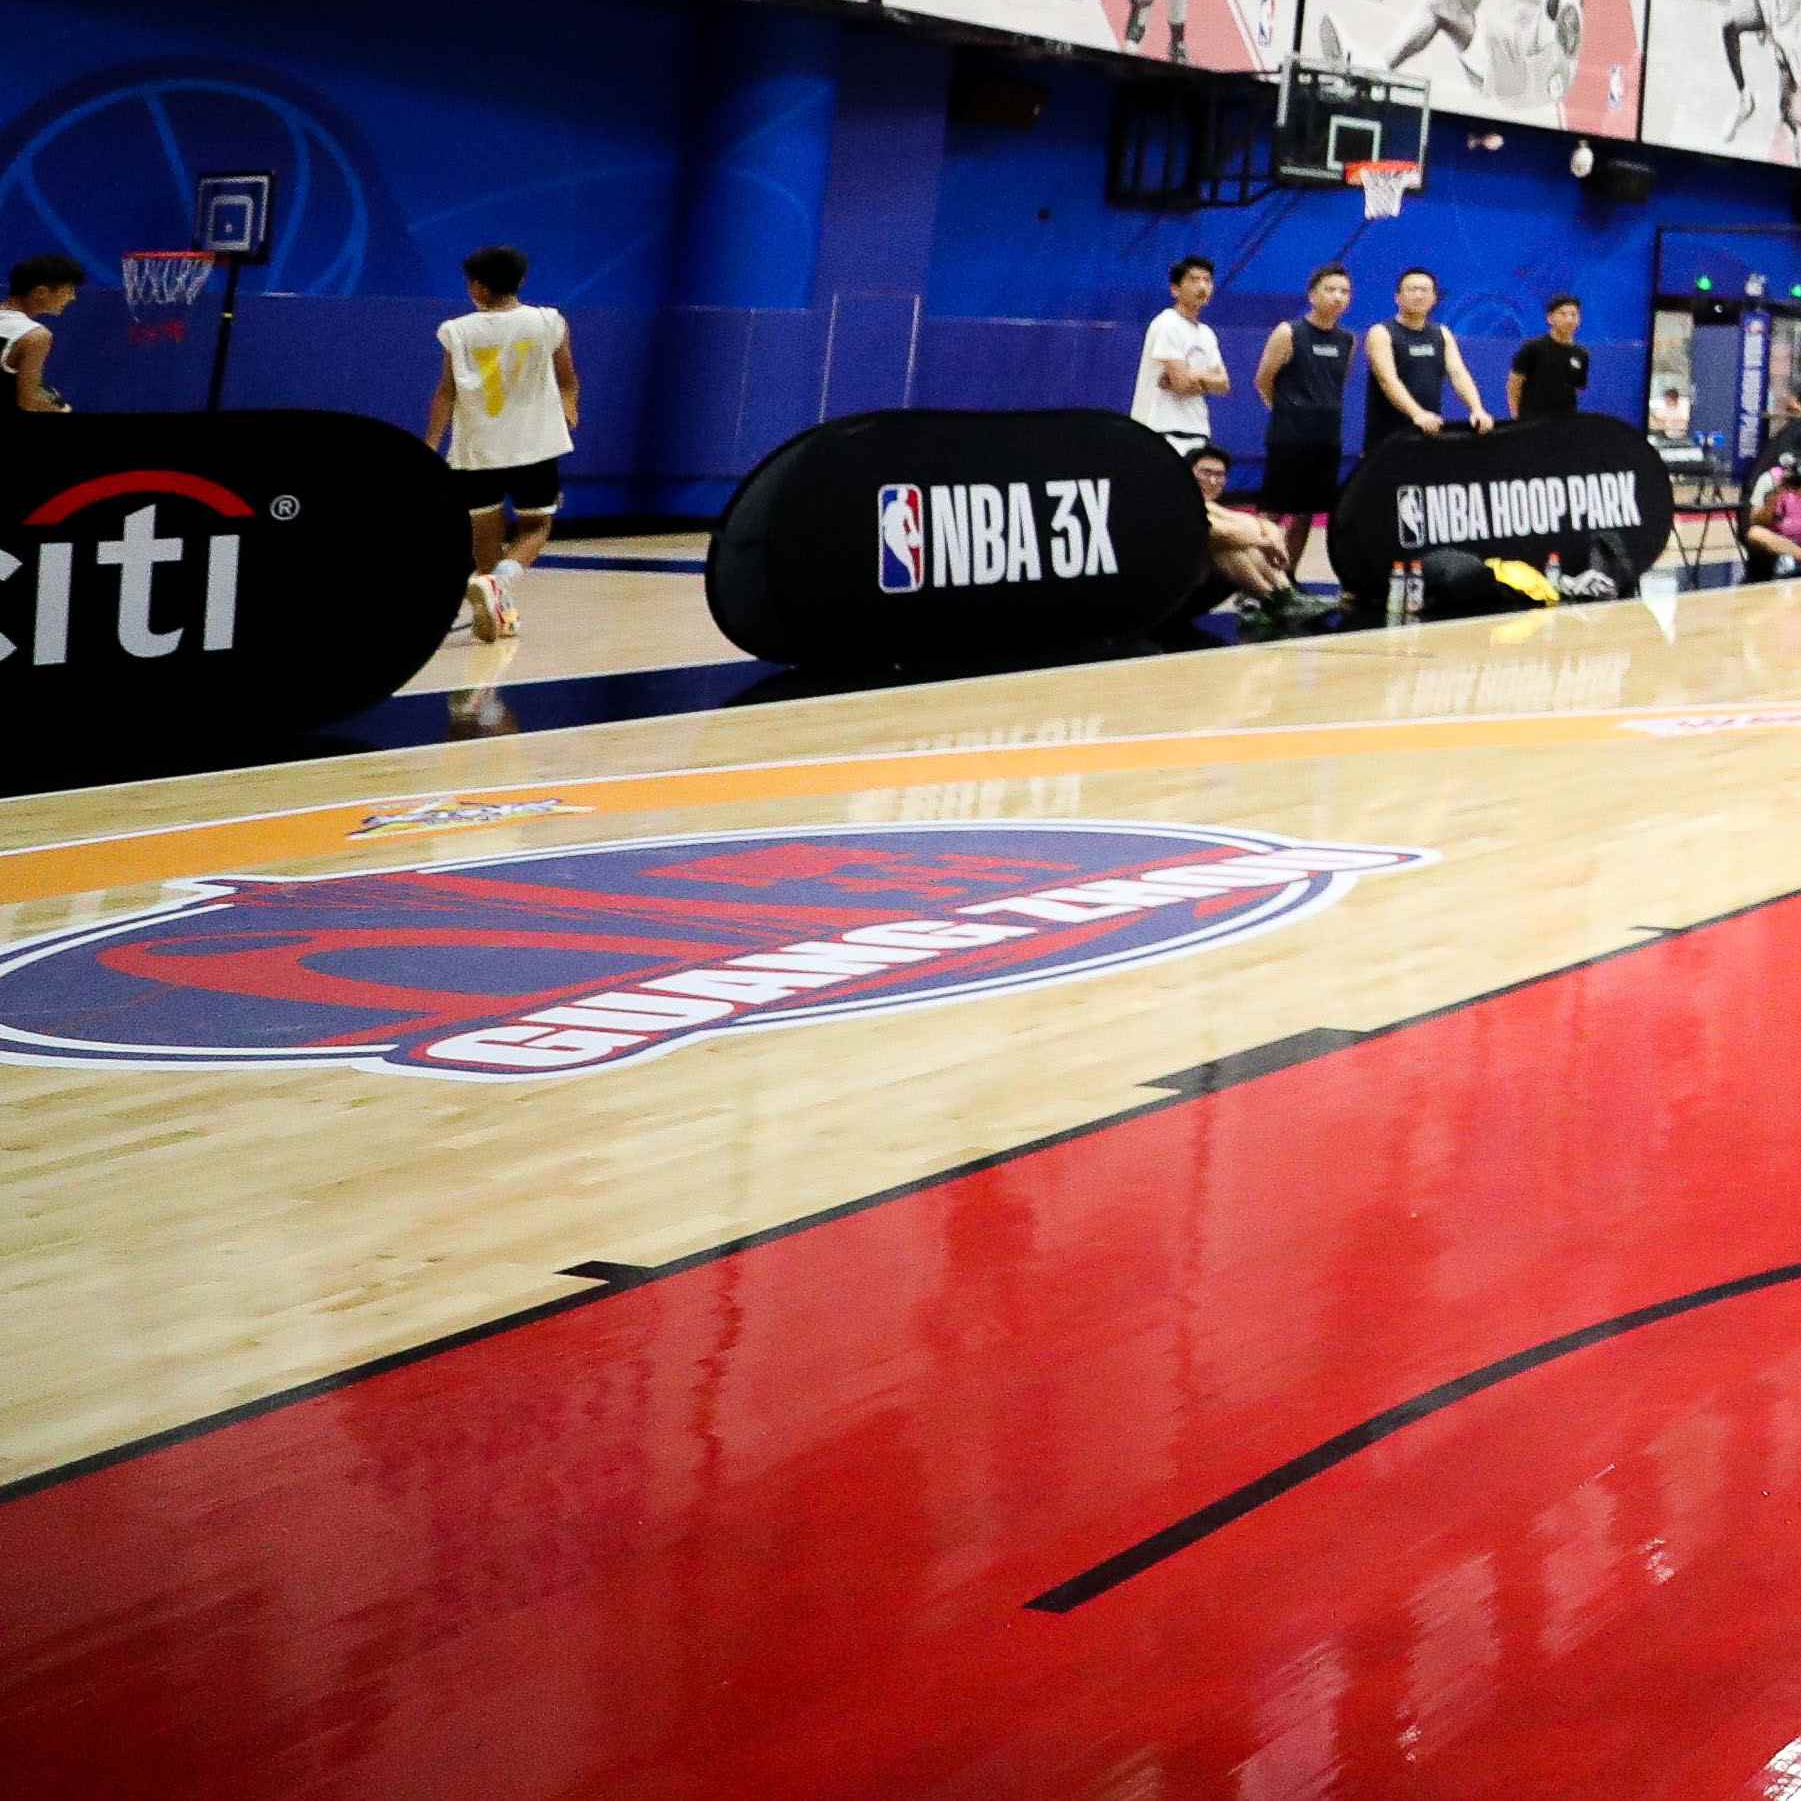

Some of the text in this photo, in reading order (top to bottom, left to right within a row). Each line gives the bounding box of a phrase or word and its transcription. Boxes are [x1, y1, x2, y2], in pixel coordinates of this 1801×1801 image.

[931, 478, 1119, 588] NBA 3X
[1425, 470, 1642, 546] NBA HOOP PARK
[428, 845, 1404, 1068] GUANG ZHOU
